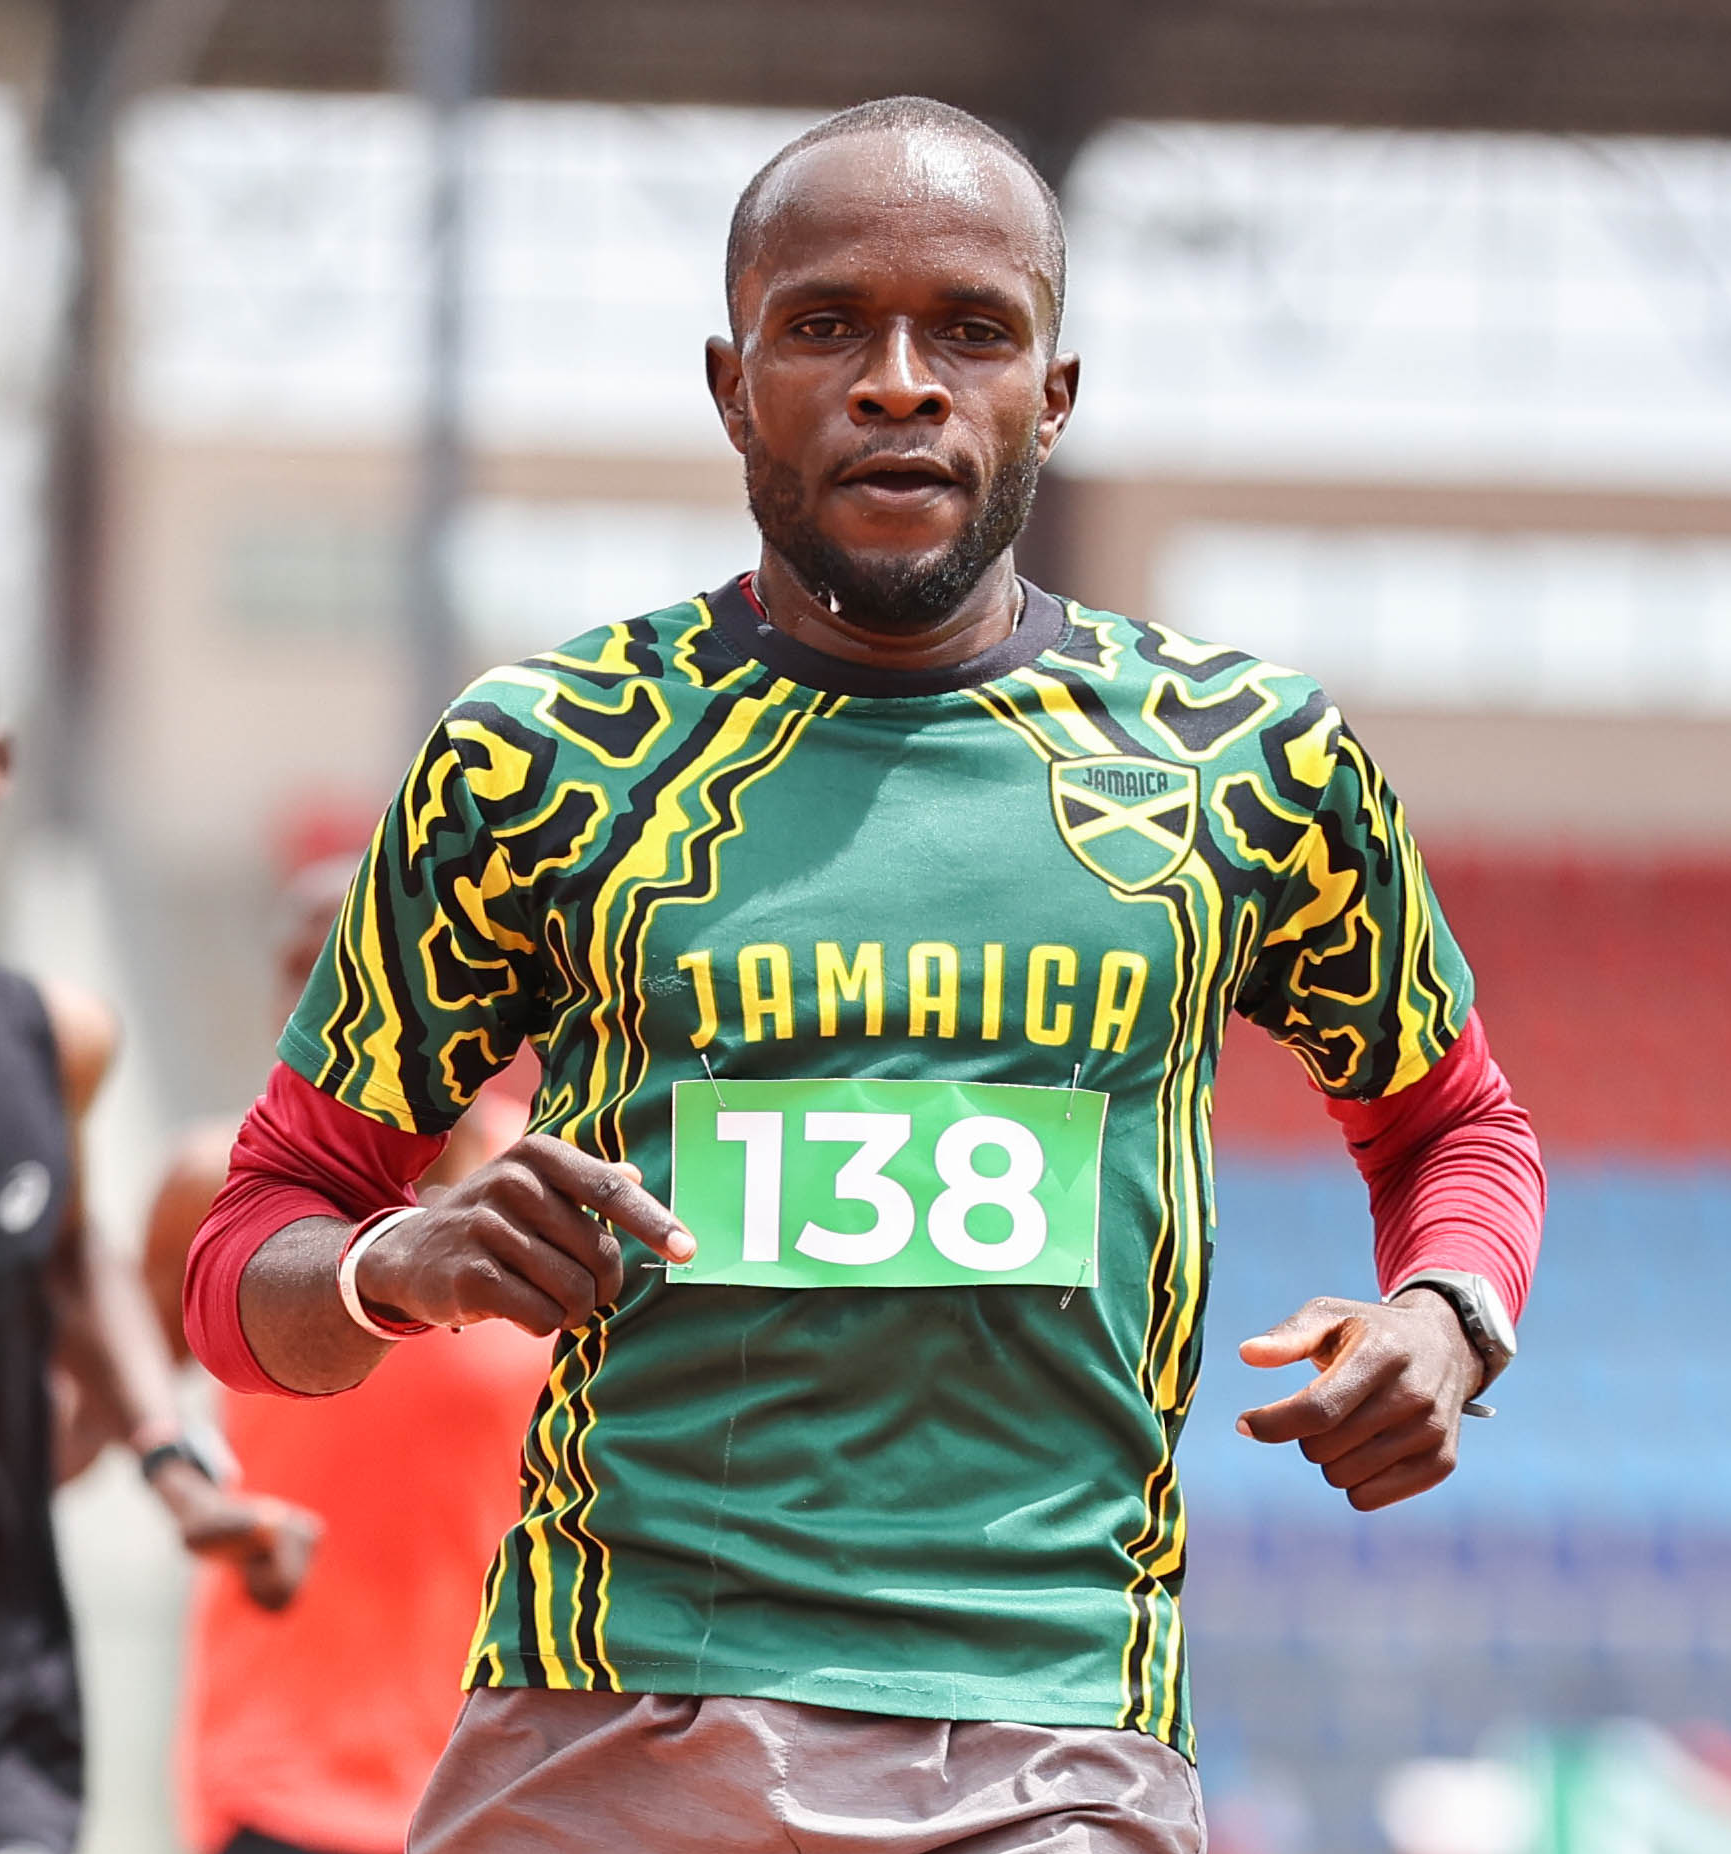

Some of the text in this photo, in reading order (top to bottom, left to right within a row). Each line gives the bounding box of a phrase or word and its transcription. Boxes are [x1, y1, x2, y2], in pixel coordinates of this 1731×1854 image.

[1082, 767, 1169, 798] JAMAICA
[676, 941, 1149, 1055] JAMAICA
[715, 1110, 1049, 1273] 138
